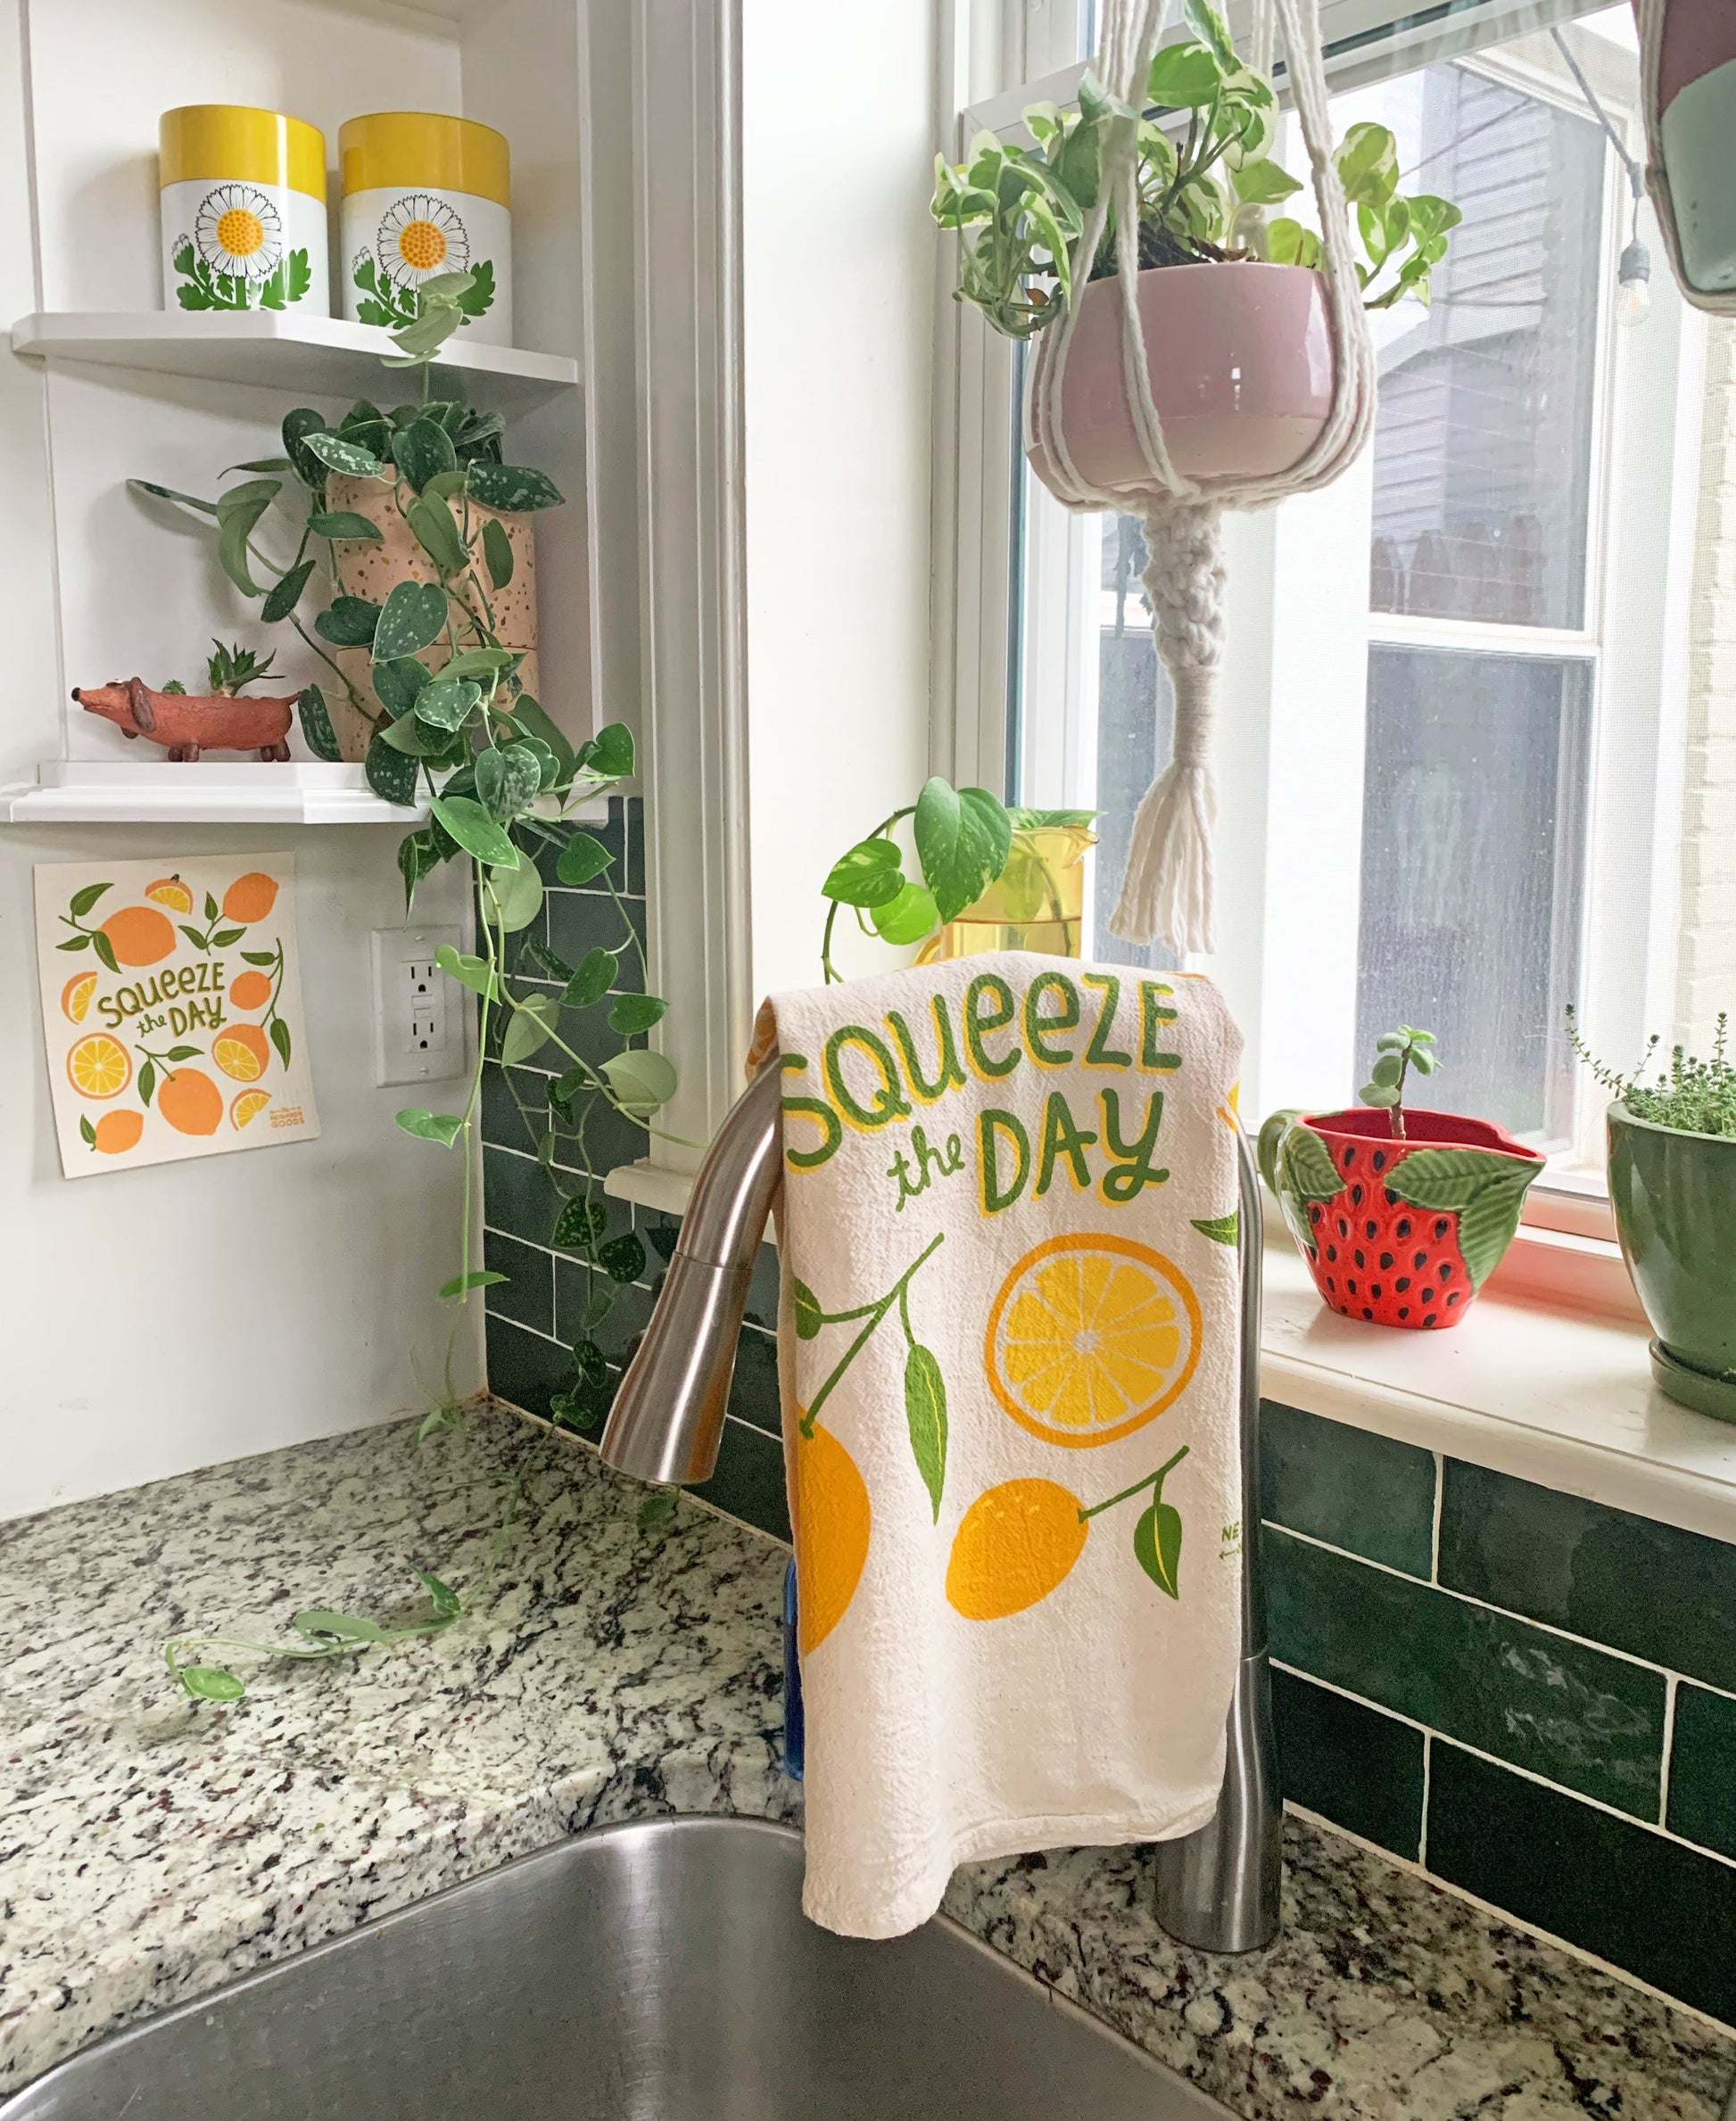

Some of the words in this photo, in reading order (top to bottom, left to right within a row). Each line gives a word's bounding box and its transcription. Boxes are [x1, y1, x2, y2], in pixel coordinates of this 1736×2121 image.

[136, 1014, 167, 1038] the
[271, 1117, 305, 1128] GOODS
[887, 1125, 966, 1212] the
